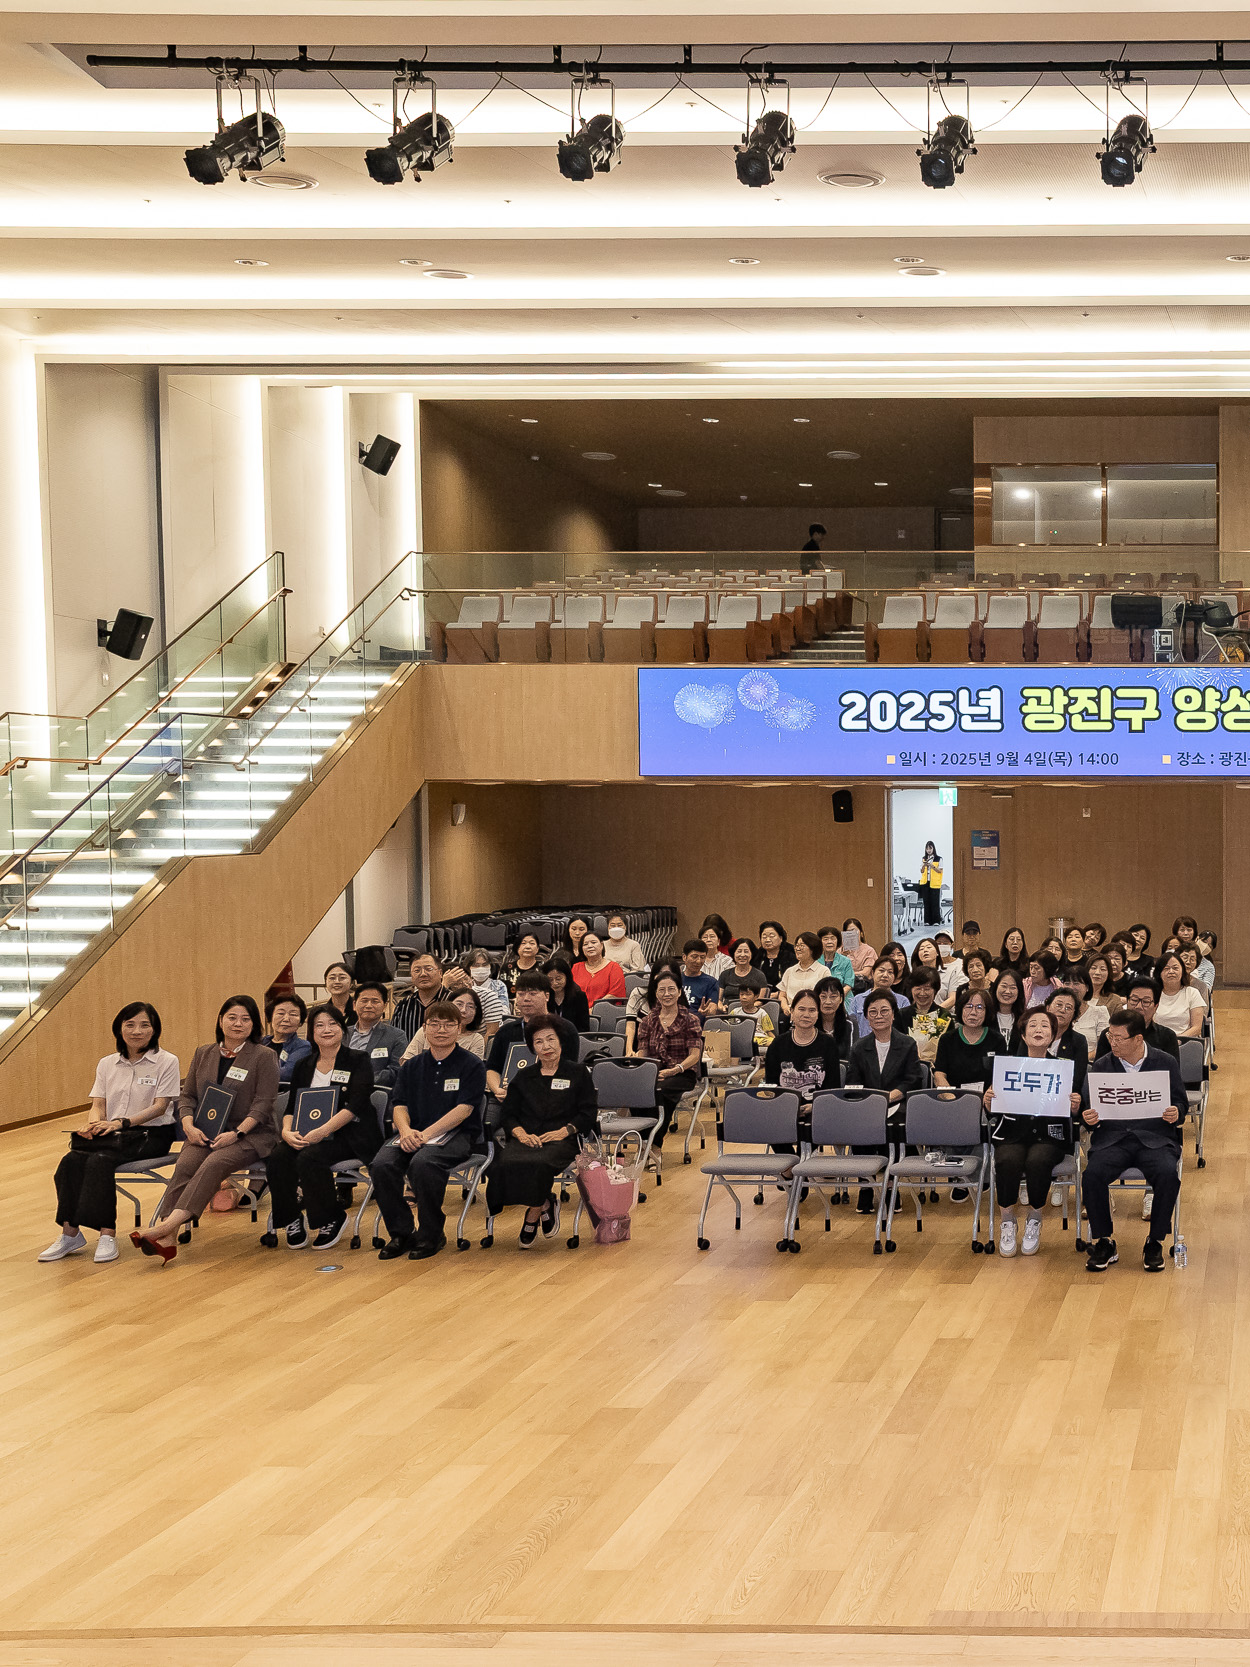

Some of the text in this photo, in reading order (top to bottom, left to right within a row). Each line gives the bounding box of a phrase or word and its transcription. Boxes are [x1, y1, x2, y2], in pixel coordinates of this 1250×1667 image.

[839, 685, 1004, 732] 2025년
[1019, 685, 1161, 733] 광진구
[899, 751, 927, 767] 일시
[940, 751, 992, 767] 2025년
[996, 751, 1019, 767] 9월
[1023, 751, 1073, 768] 4일(목)
[1078, 752, 1119, 766] 14:00
[1176, 751, 1206, 767] 장소
[1003, 1071, 1062, 1095] 모두가
[1098, 1086, 1162, 1105] 존중받는
